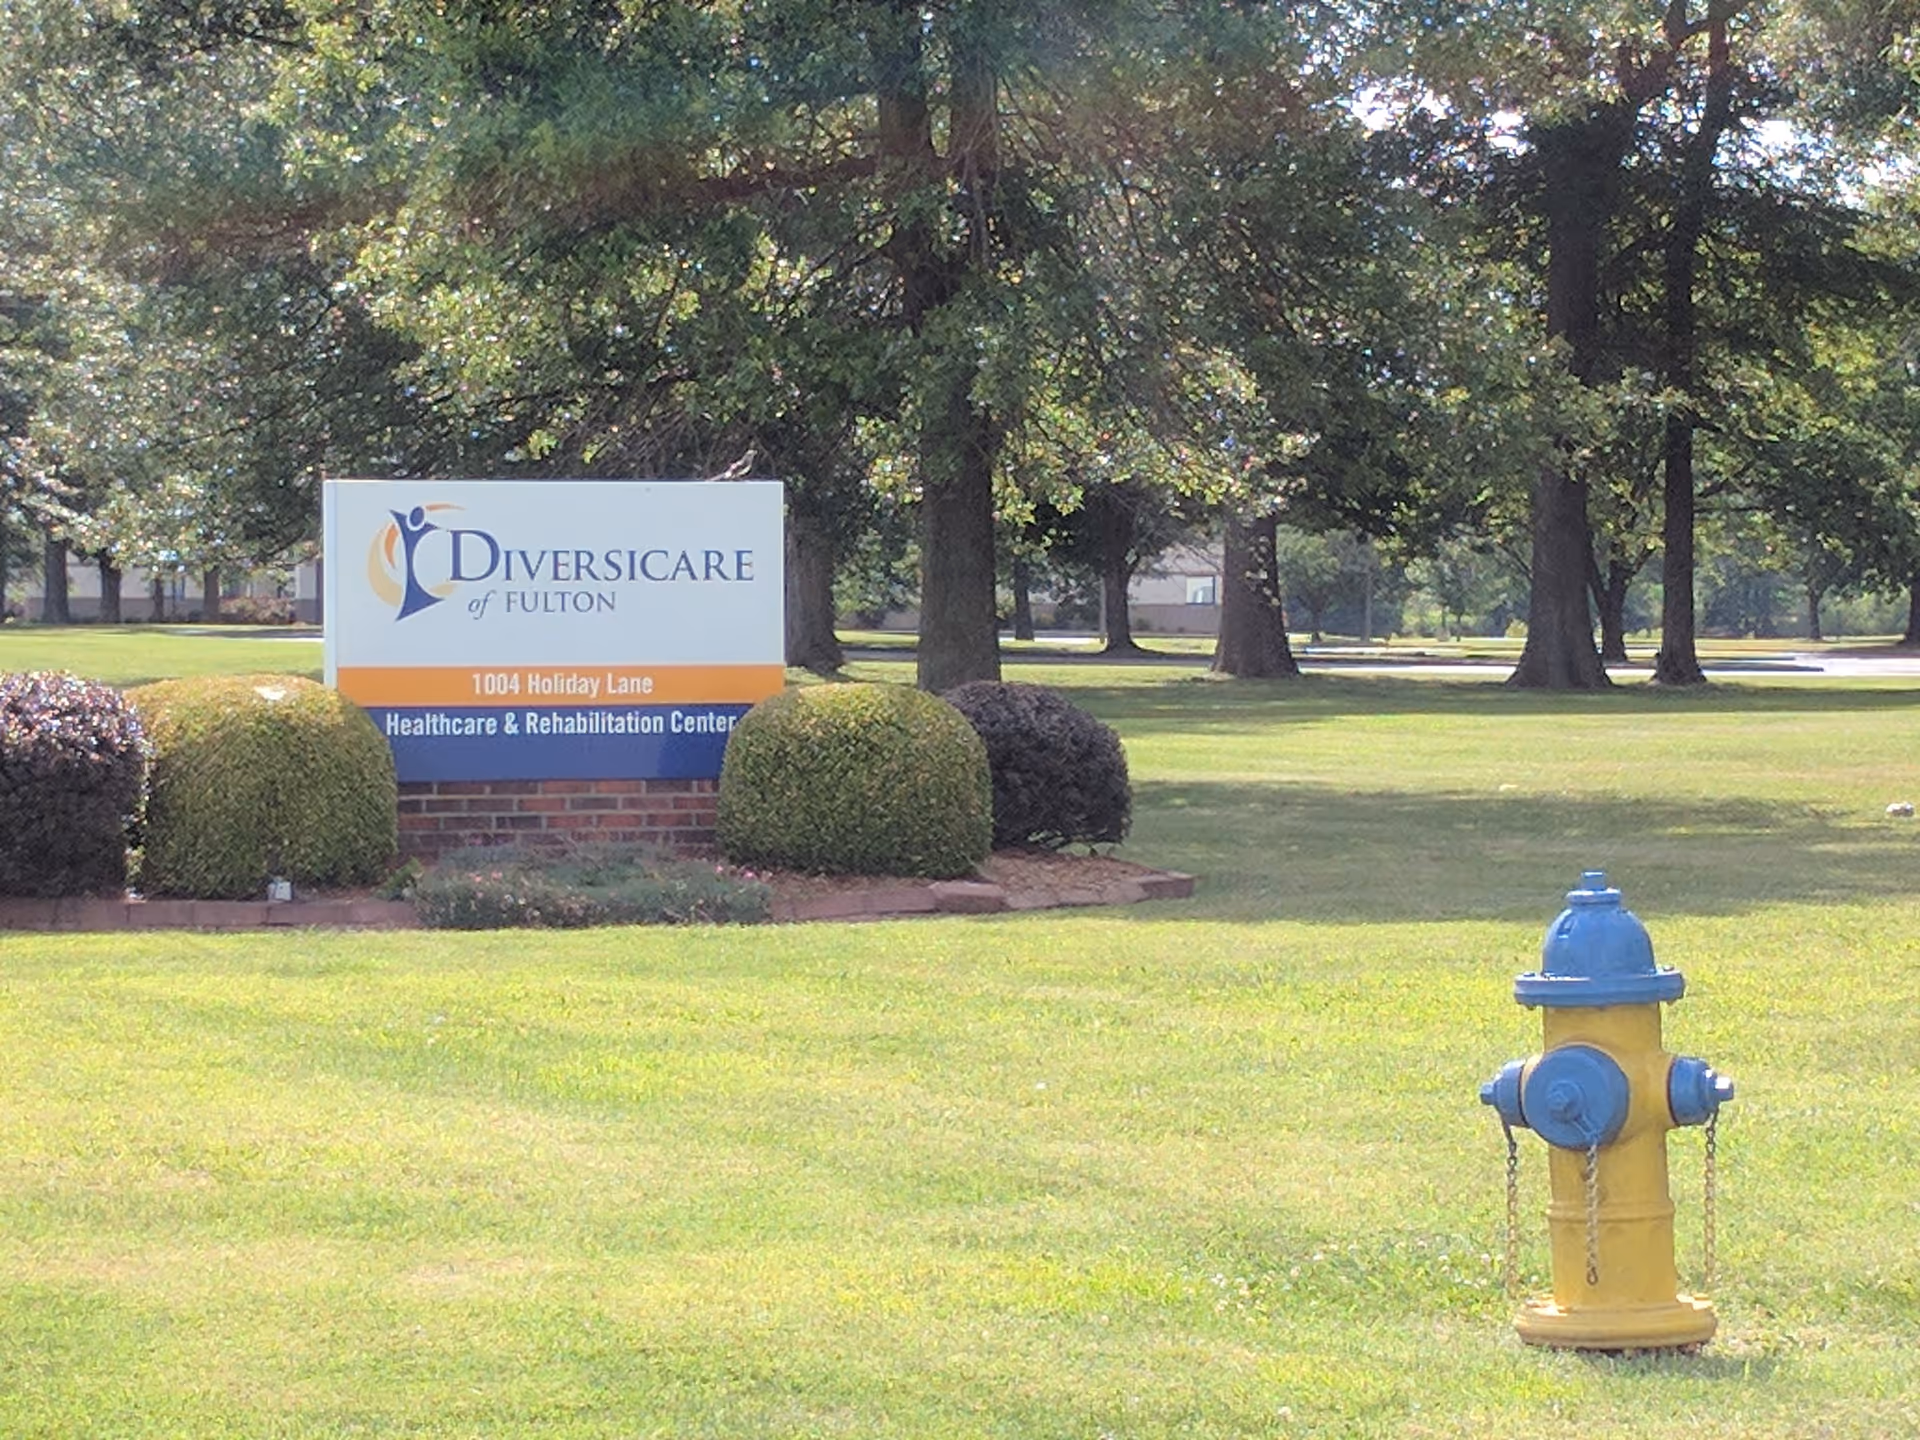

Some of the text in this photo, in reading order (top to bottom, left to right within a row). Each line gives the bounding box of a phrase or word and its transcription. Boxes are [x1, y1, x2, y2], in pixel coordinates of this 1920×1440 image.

[449, 529, 754, 582] DIVERSICARE
[468, 589, 616, 619] of FULTON
[472, 673, 653, 697] 1004 Holiday Lane
[386, 710, 737, 736] Healthcare & Rehabilitation Center
